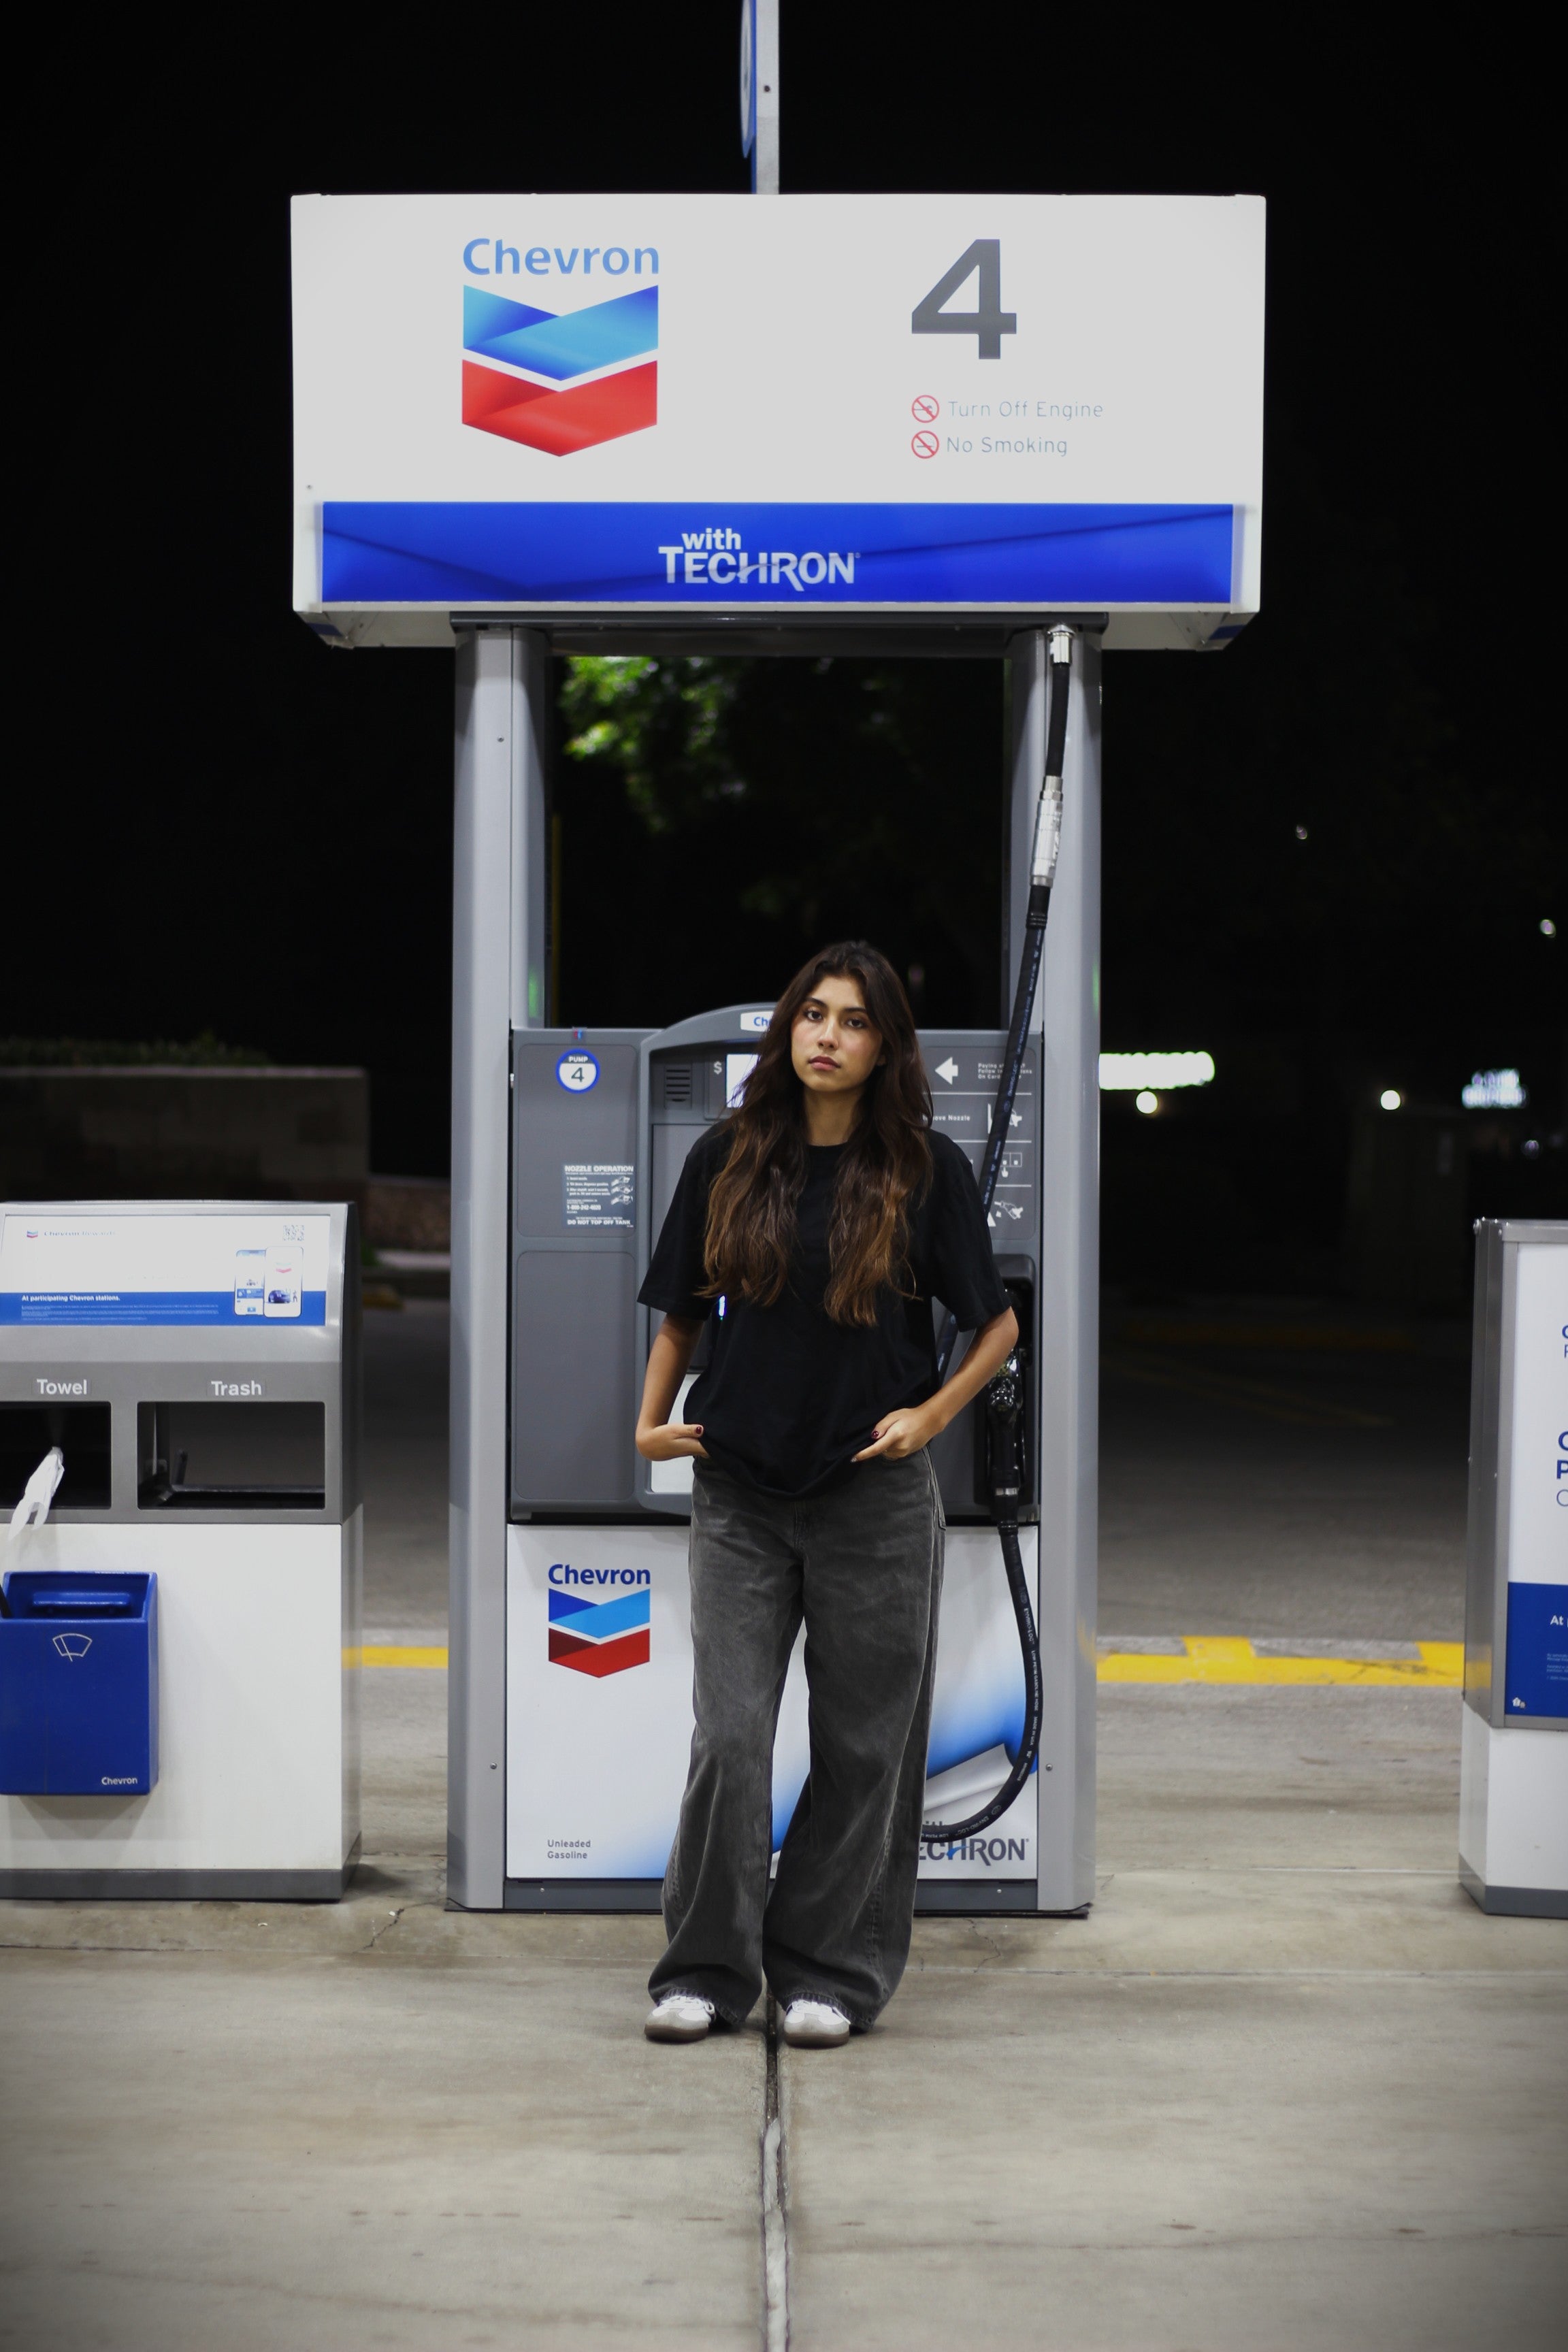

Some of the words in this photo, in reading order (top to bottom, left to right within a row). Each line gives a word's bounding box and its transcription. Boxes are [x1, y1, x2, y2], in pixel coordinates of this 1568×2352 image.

[463, 238, 659, 275] Chevron
[912, 239, 1017, 359] 4
[948, 402, 990, 416] Turn
[999, 402, 1027, 416] Off
[1036, 402, 1102, 421] Engine
[947, 437, 972, 453] No
[981, 437, 1067, 457] Smoking
[681, 528, 741, 550] with
[571, 1067, 585, 1082] 4
[37, 1379, 87, 1395] Towel
[211, 1380, 262, 1396] Trash
[549, 1563, 650, 1584] Chevron
[1550, 1616, 1564, 1626] At
[101, 1777, 137, 1785] Chevron
